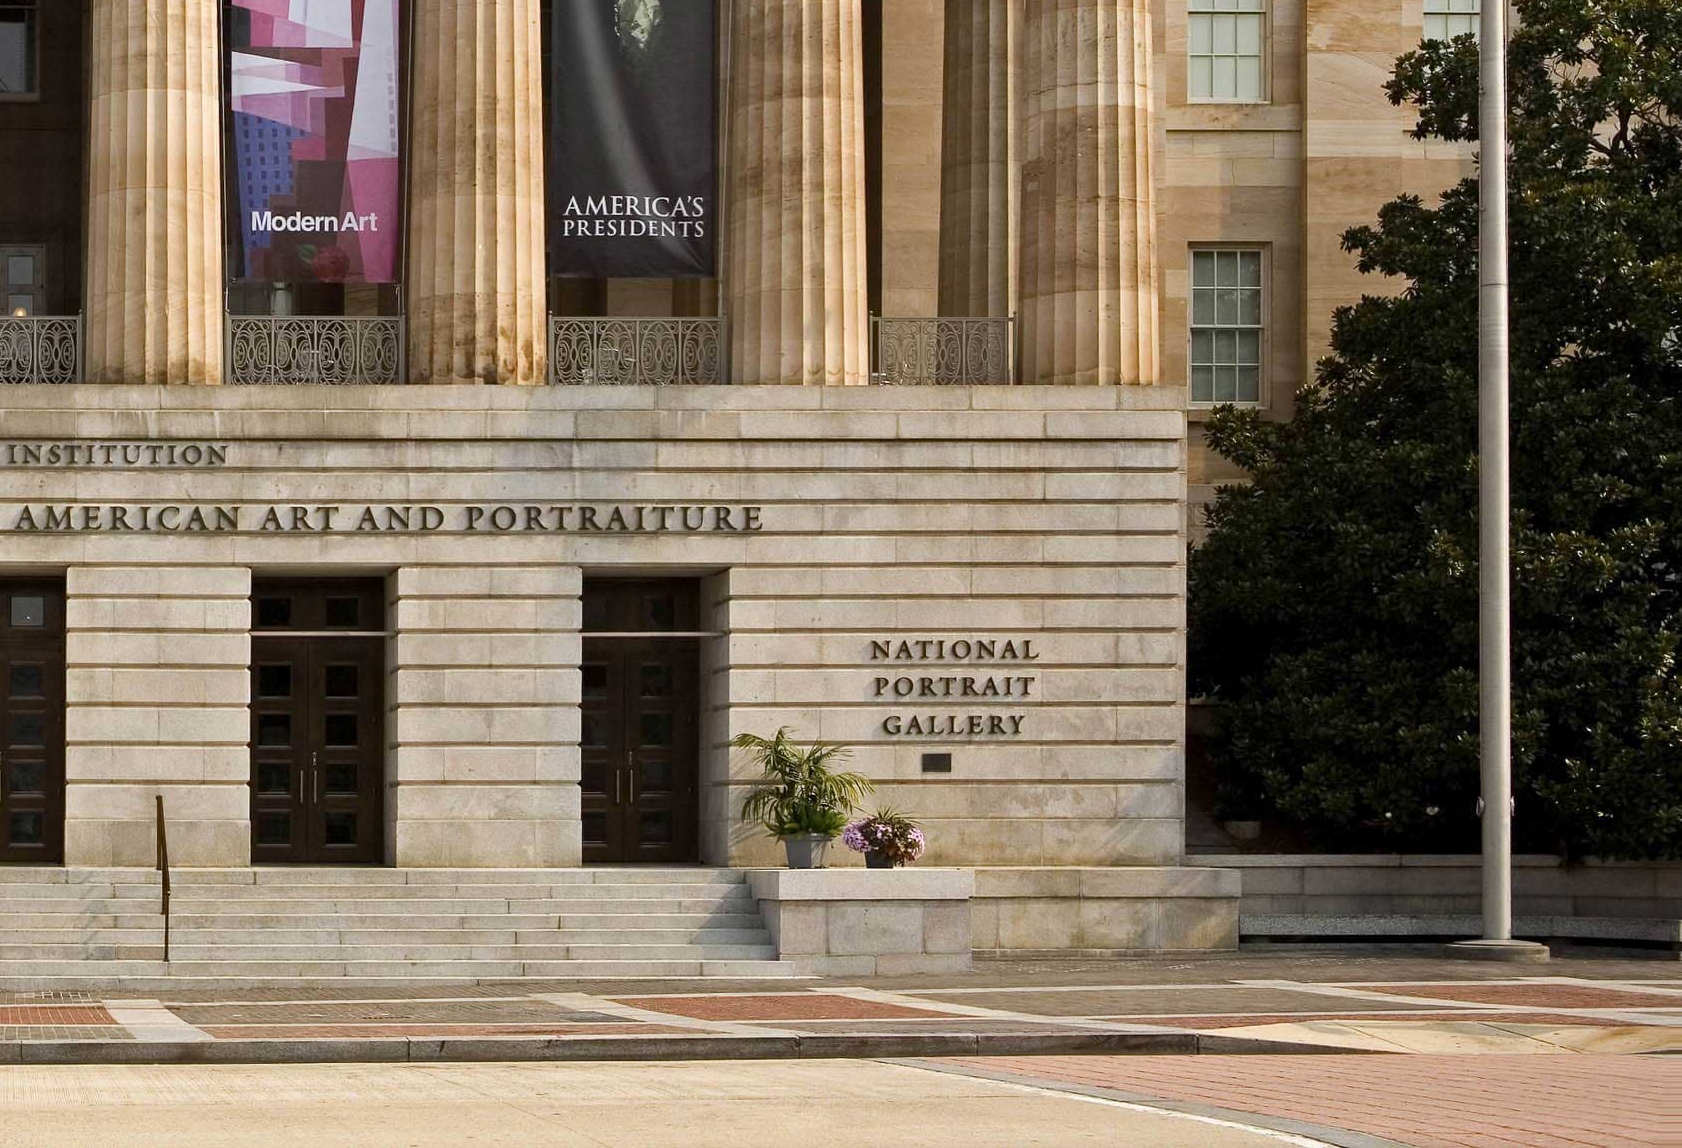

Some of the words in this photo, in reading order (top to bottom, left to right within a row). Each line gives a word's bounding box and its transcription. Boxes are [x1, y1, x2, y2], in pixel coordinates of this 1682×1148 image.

[563, 195, 704, 218] AMERICA'S
[251, 211, 338, 232] Modern
[340, 211, 378, 232] Art
[563, 219, 704, 238] PRESIDENTS
[7, 444, 228, 466] INSTITUTION
[17, 505, 240, 532] AMERICAN
[259, 506, 340, 532] ART
[355, 506, 445, 532] AND
[465, 506, 764, 532] PORTRAITURE
[870, 639, 1039, 660] NATIONAL
[874, 677, 1035, 697] PORTRAIT
[882, 715, 1025, 736] GALLERY
